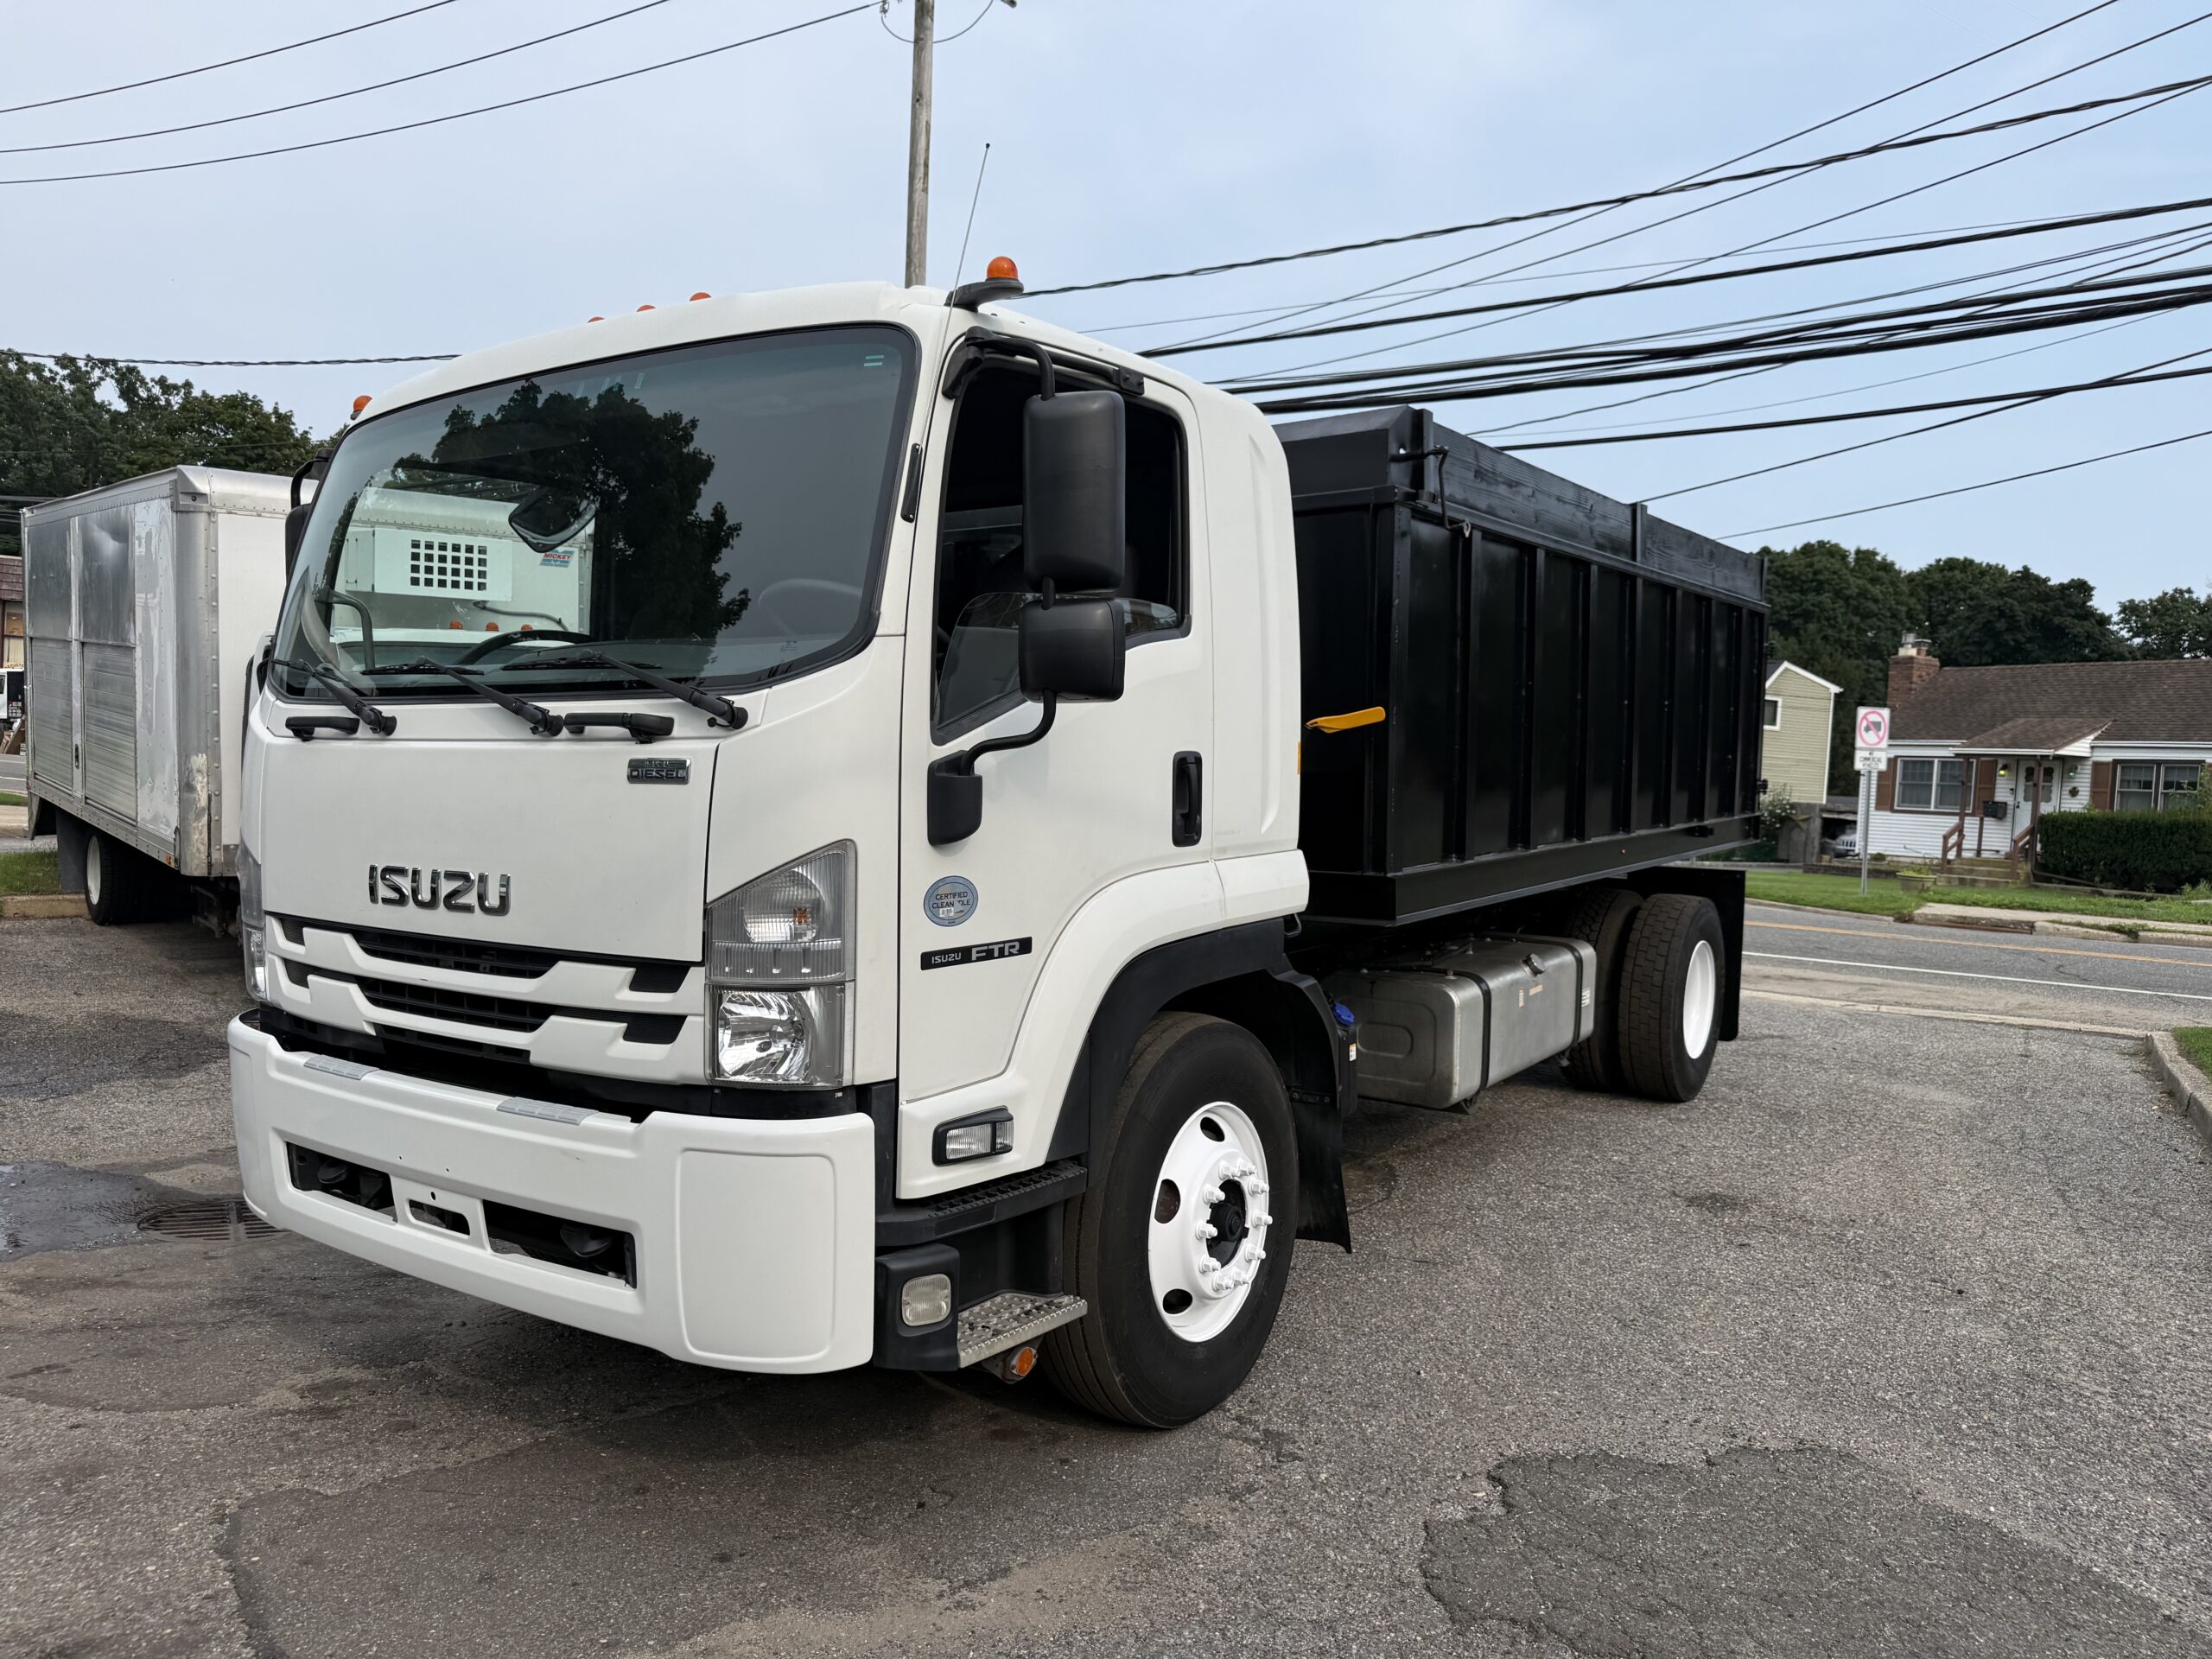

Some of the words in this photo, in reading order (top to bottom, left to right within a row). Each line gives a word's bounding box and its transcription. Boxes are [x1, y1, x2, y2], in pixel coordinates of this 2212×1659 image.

[630, 768, 686, 780] DIESEL
[369, 864, 512, 917] ISUZU
[935, 891, 969, 900] CERTIFIED
[931, 900, 955, 909] CLEAN
[931, 952, 962, 964] ISUZU
[971, 941, 1020, 961] FTR
